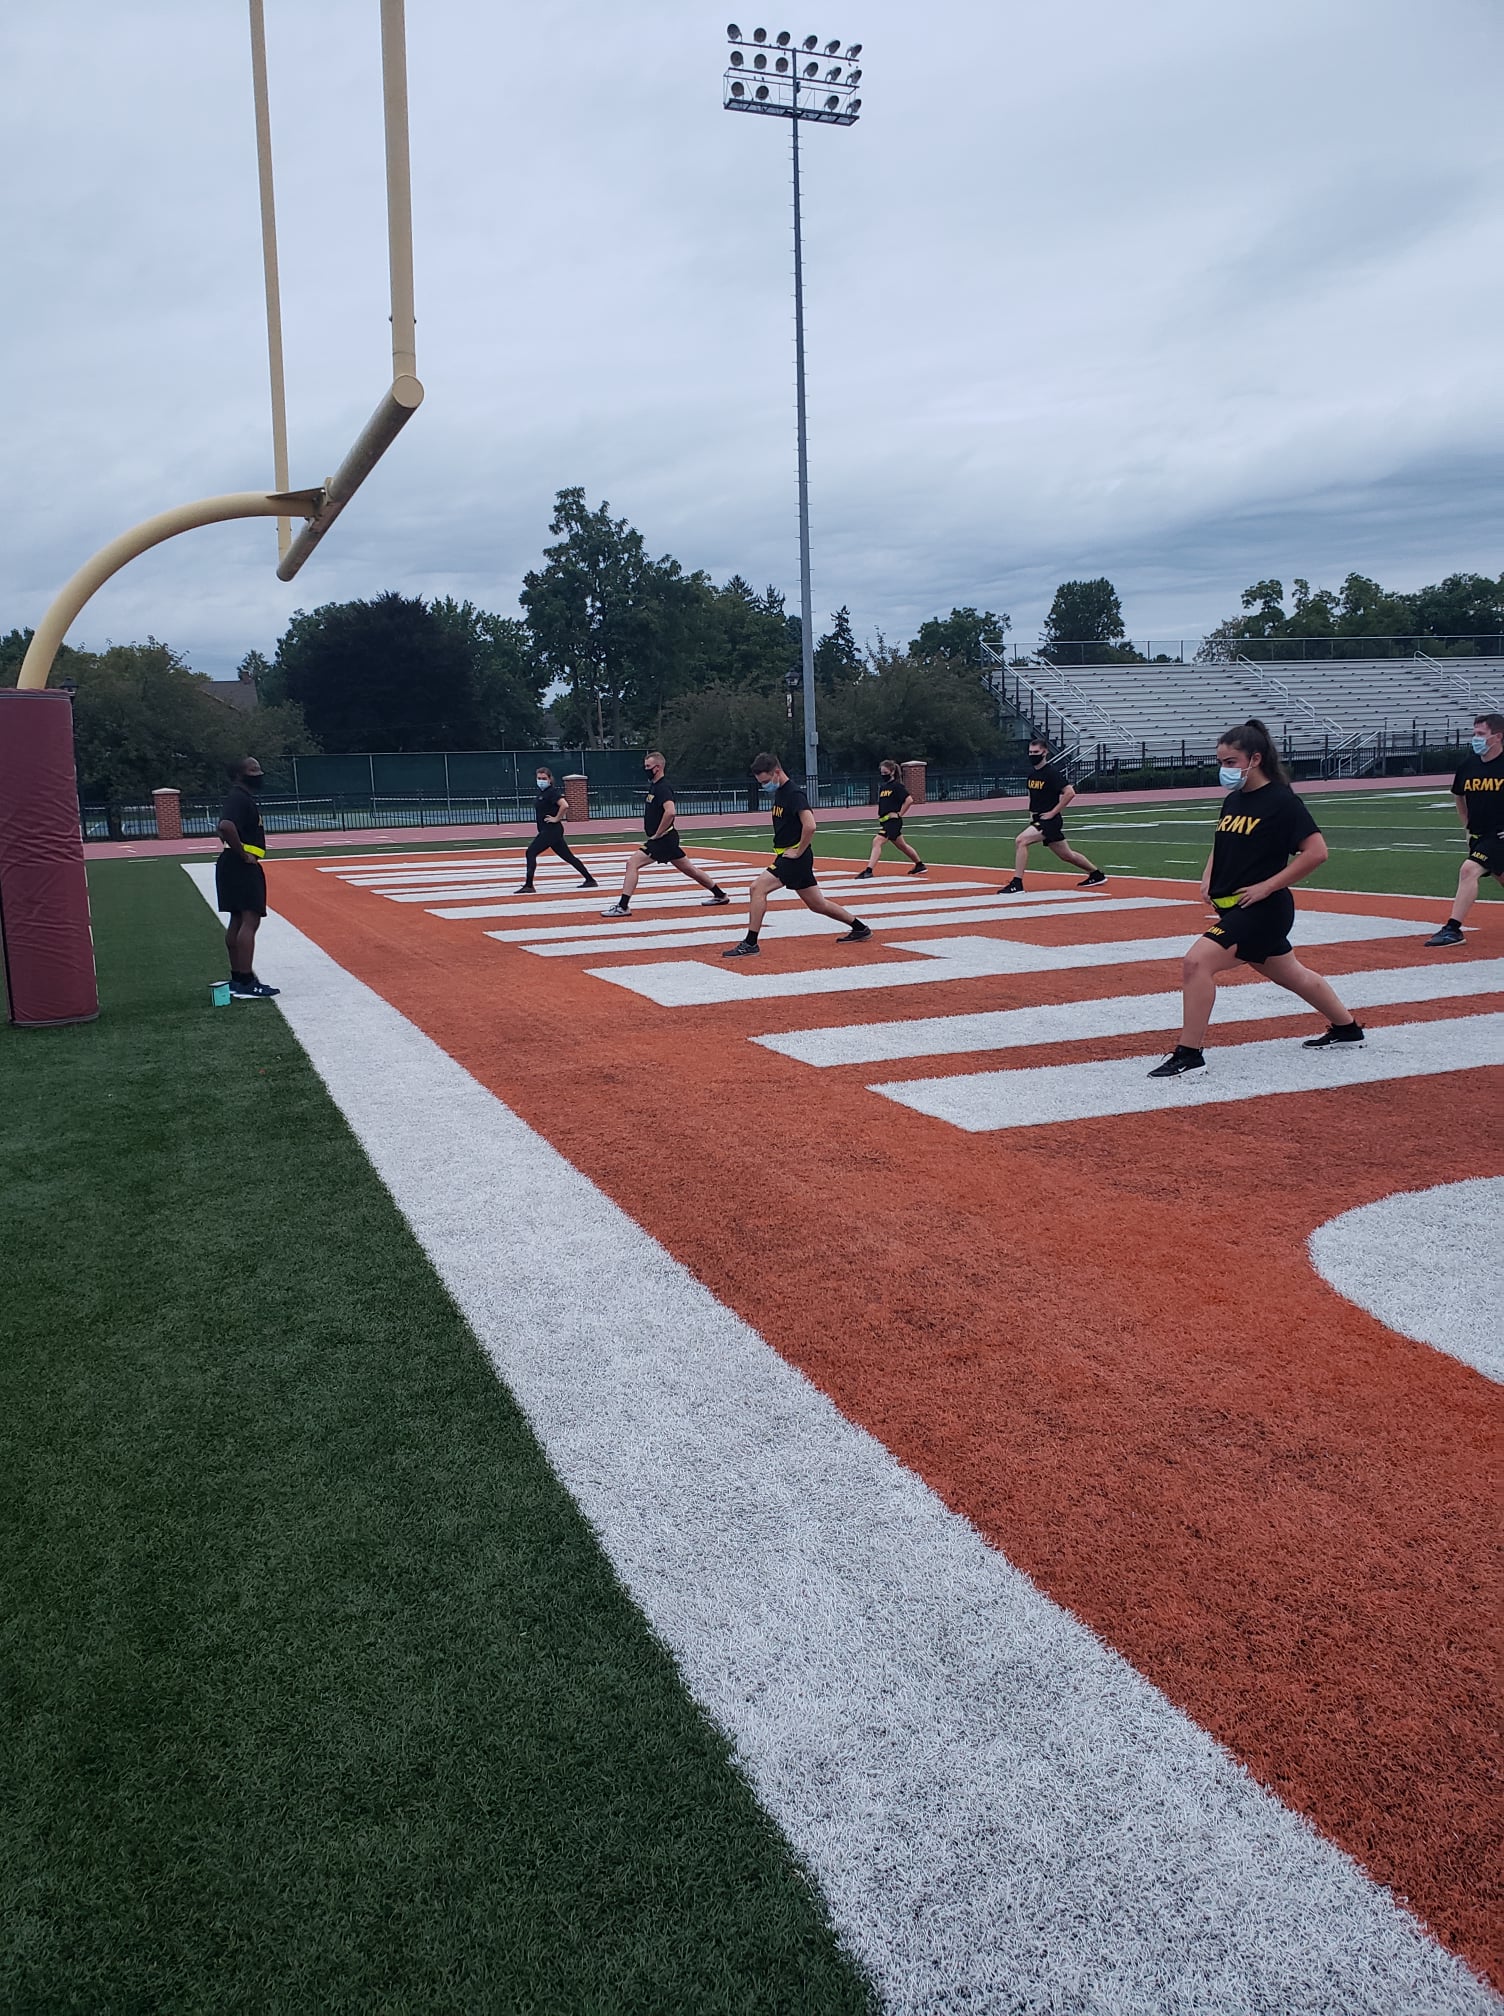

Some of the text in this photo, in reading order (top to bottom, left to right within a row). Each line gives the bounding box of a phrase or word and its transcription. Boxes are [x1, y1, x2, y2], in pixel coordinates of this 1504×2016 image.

[1464, 778, 1504, 792] ARMY
[1216, 815, 1261, 835] RMY
[1471, 851, 1488, 862] ARMY
